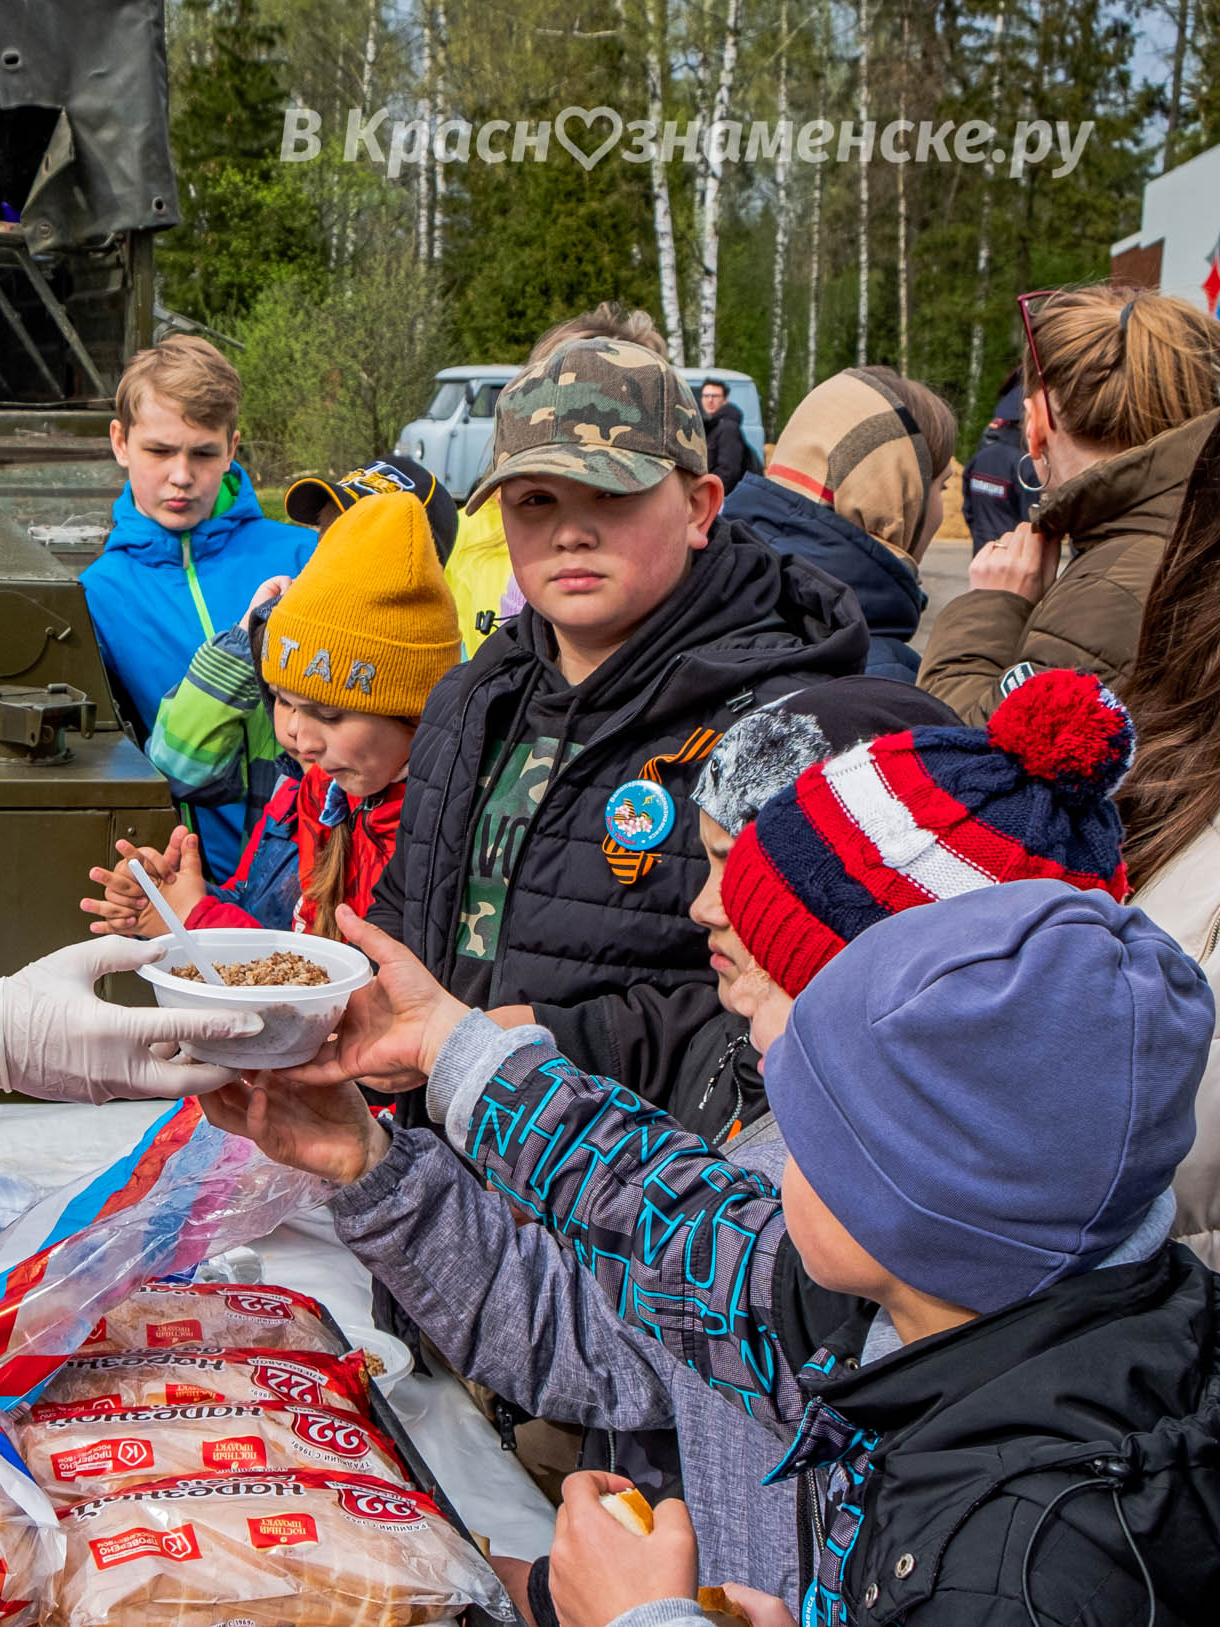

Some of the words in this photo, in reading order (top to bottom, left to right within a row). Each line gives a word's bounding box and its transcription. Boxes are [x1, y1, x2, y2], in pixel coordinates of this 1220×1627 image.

[239, 1297, 283, 1315] 22
[266, 1368, 313, 1404] 22
[308, 1416, 359, 1449] 22
[212, 1451, 257, 1460] ПОСТНЫЙ
[214, 1443, 254, 1452] ПРОДУКТ
[352, 1491, 412, 1516] 22
[258, 1525, 307, 1536] ПОСТНЫЙ
[260, 1518, 302, 1529] ПРОДУКТ
[98, 1537, 159, 1556] ПРОВЕРЕНО
